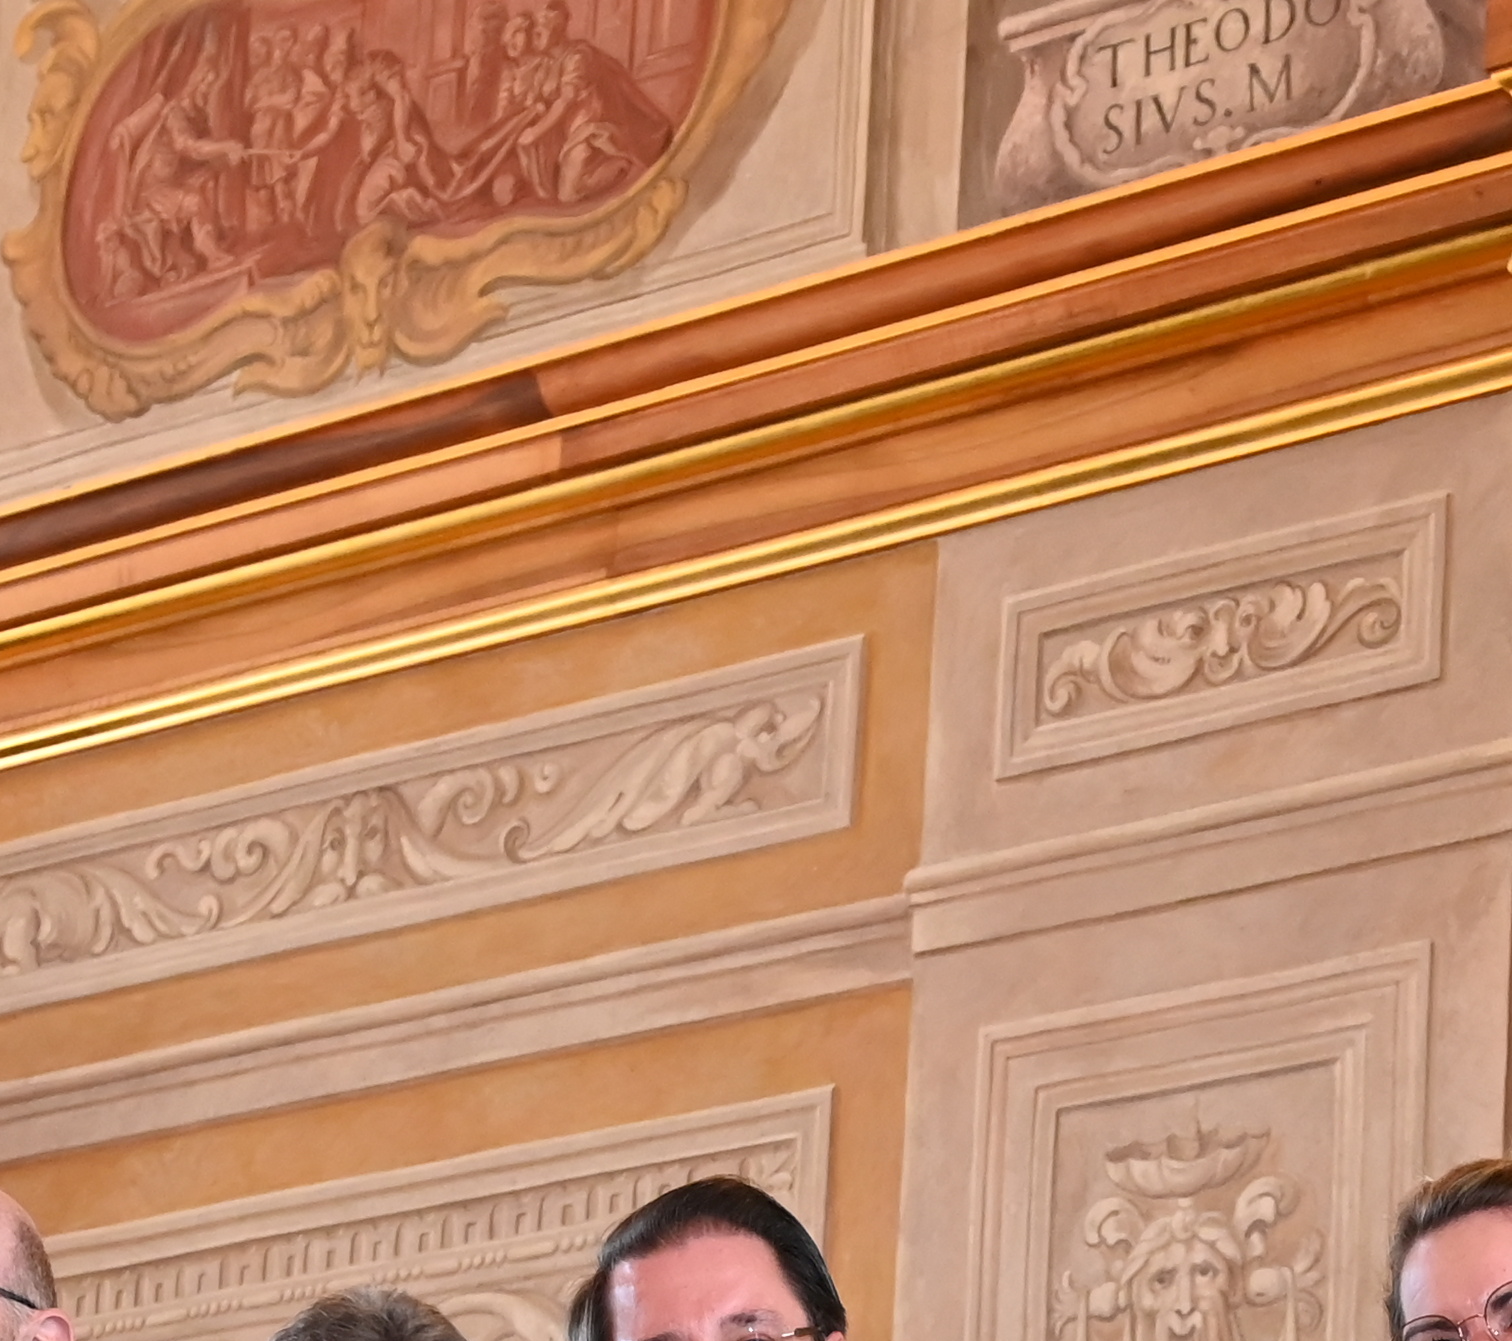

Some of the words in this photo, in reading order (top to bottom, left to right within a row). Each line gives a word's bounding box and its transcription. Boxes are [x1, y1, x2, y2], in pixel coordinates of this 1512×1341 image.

[1096, 0, 1340, 88] THEODO
[1102, 78, 1233, 154] SIVS.
[1246, 54, 1292, 112] M
